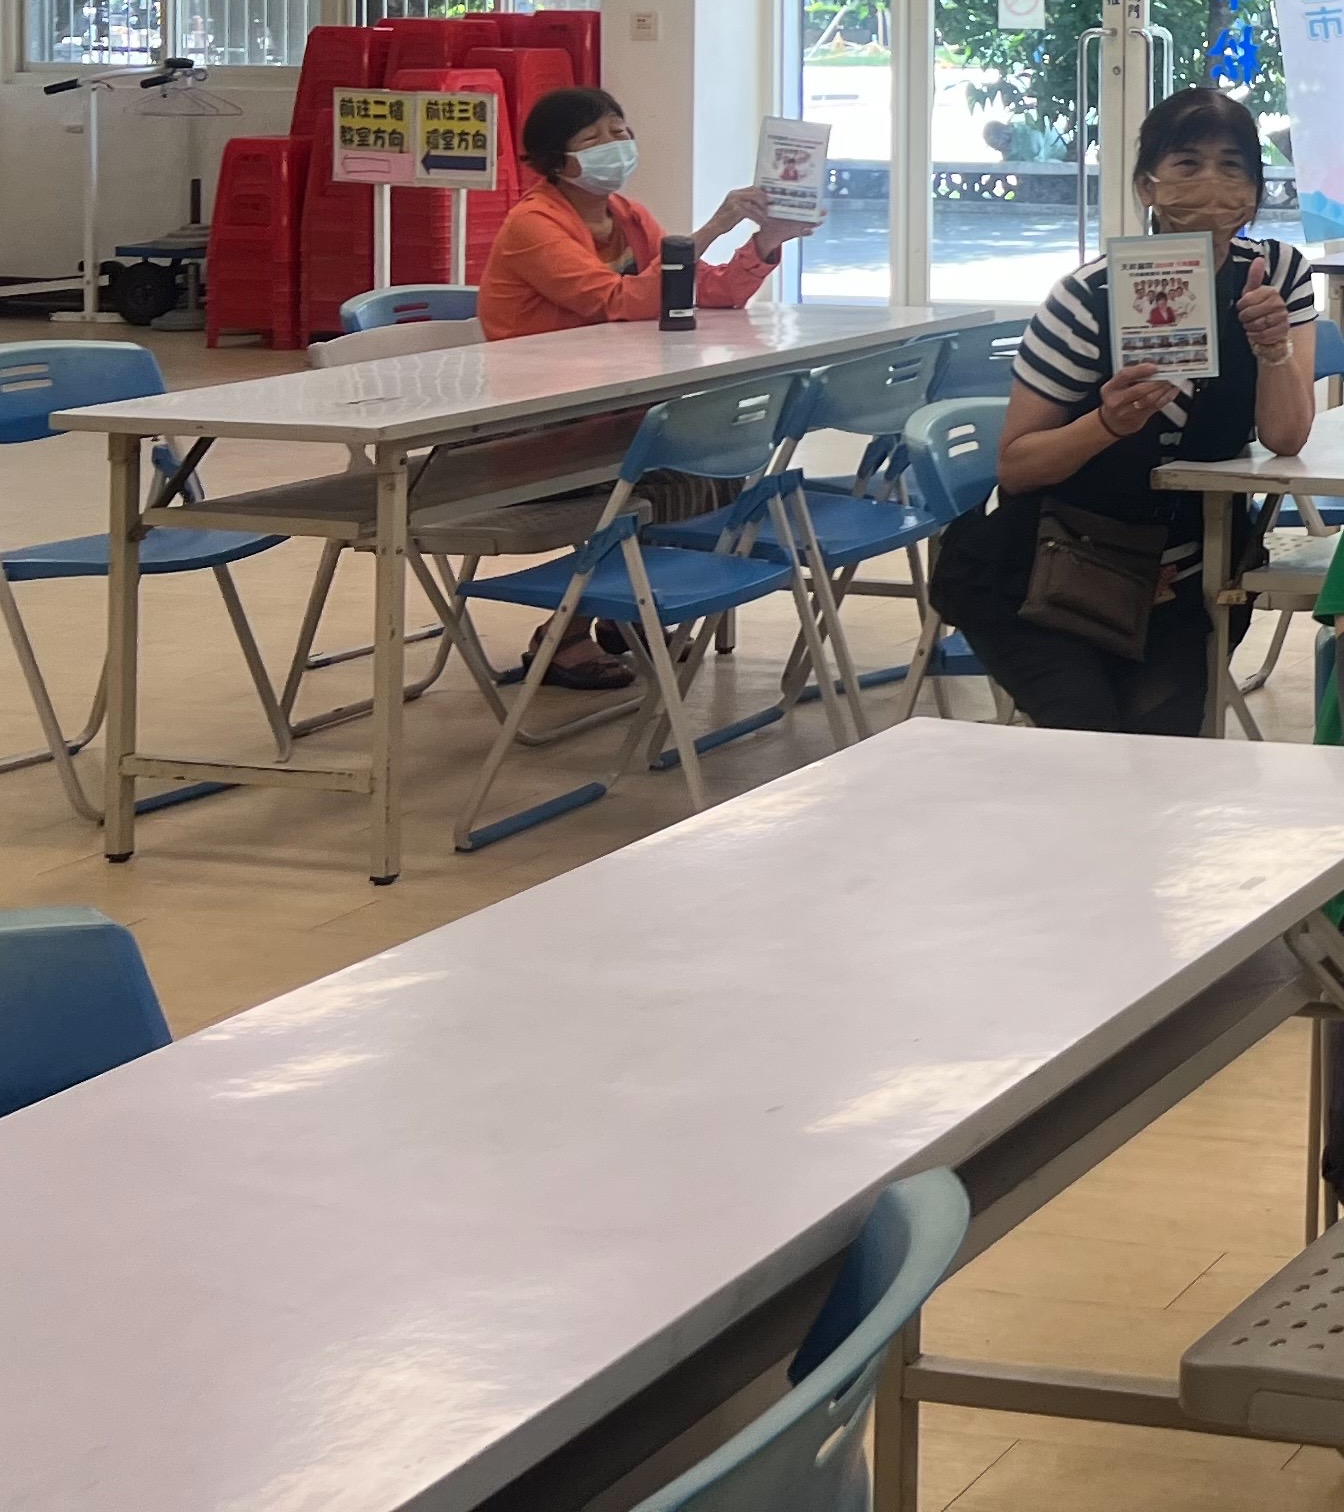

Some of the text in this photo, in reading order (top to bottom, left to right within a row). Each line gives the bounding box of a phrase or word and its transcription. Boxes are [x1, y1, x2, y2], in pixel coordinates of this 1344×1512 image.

[339, 97, 404, 121] 前往二樓
[425, 99, 487, 122] 前往三樓
[339, 125, 405, 153] 教室方向
